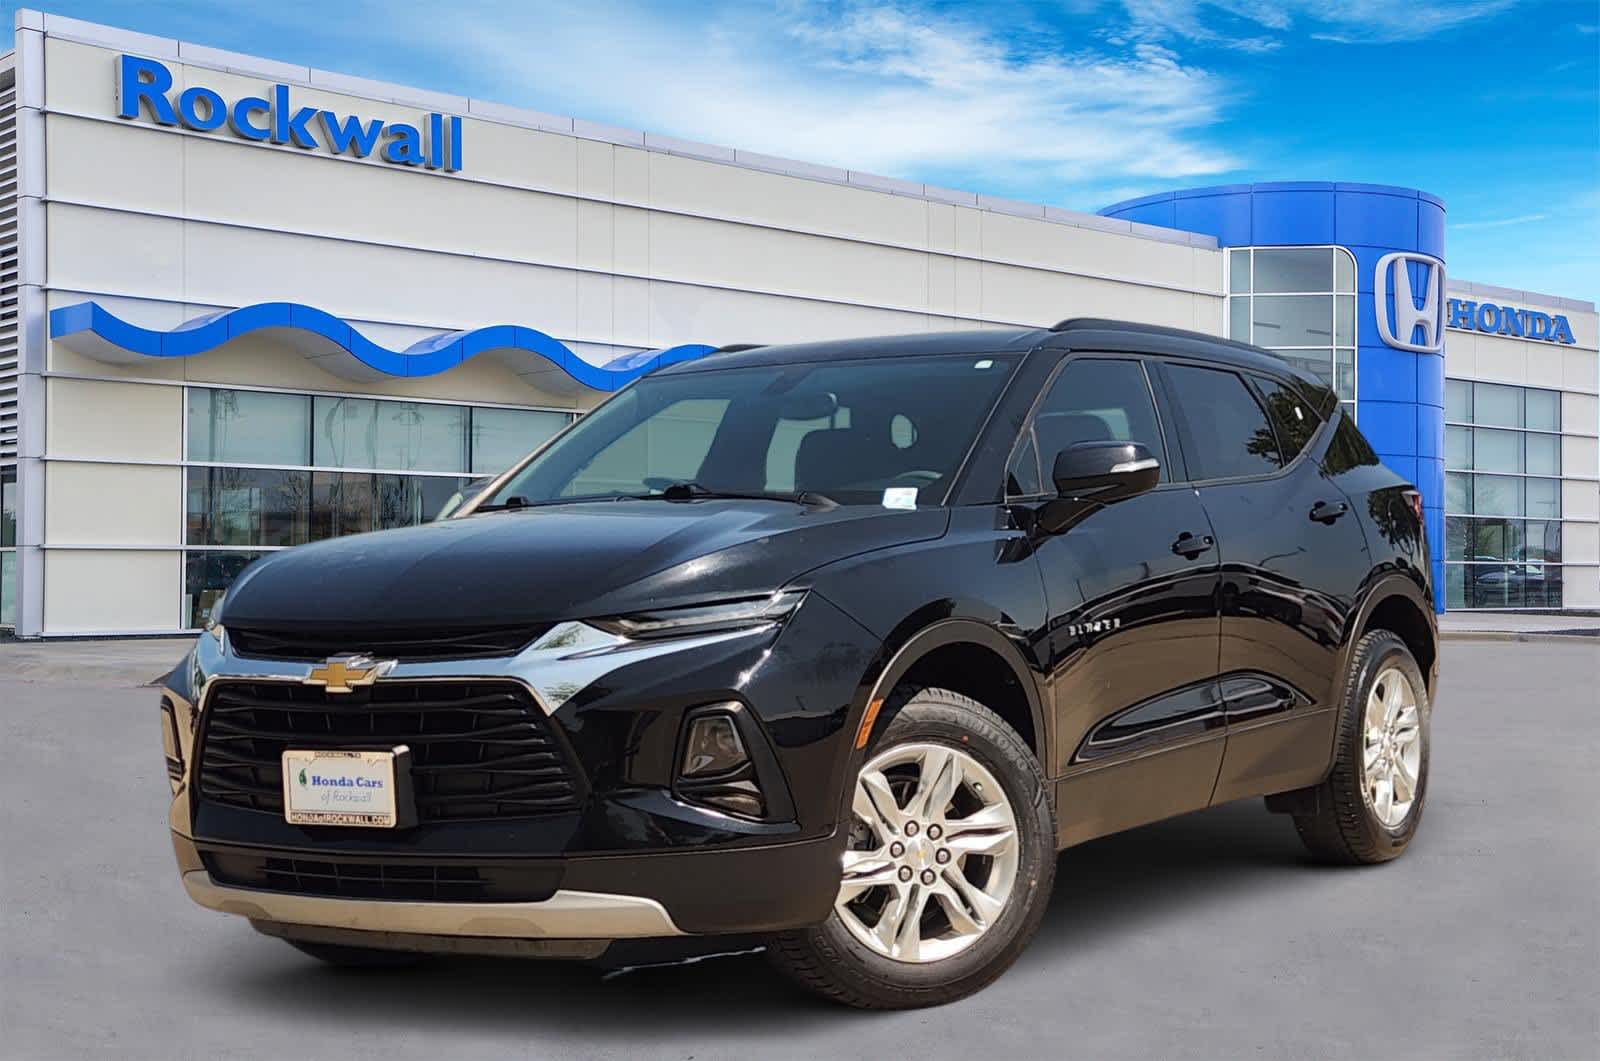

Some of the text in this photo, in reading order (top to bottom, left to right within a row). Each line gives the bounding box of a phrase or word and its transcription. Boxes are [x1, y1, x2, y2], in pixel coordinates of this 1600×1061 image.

[117, 54, 463, 172] Rockwall
[1447, 298, 1577, 345] HONDA
[311, 775, 384, 788] Honda Cars
